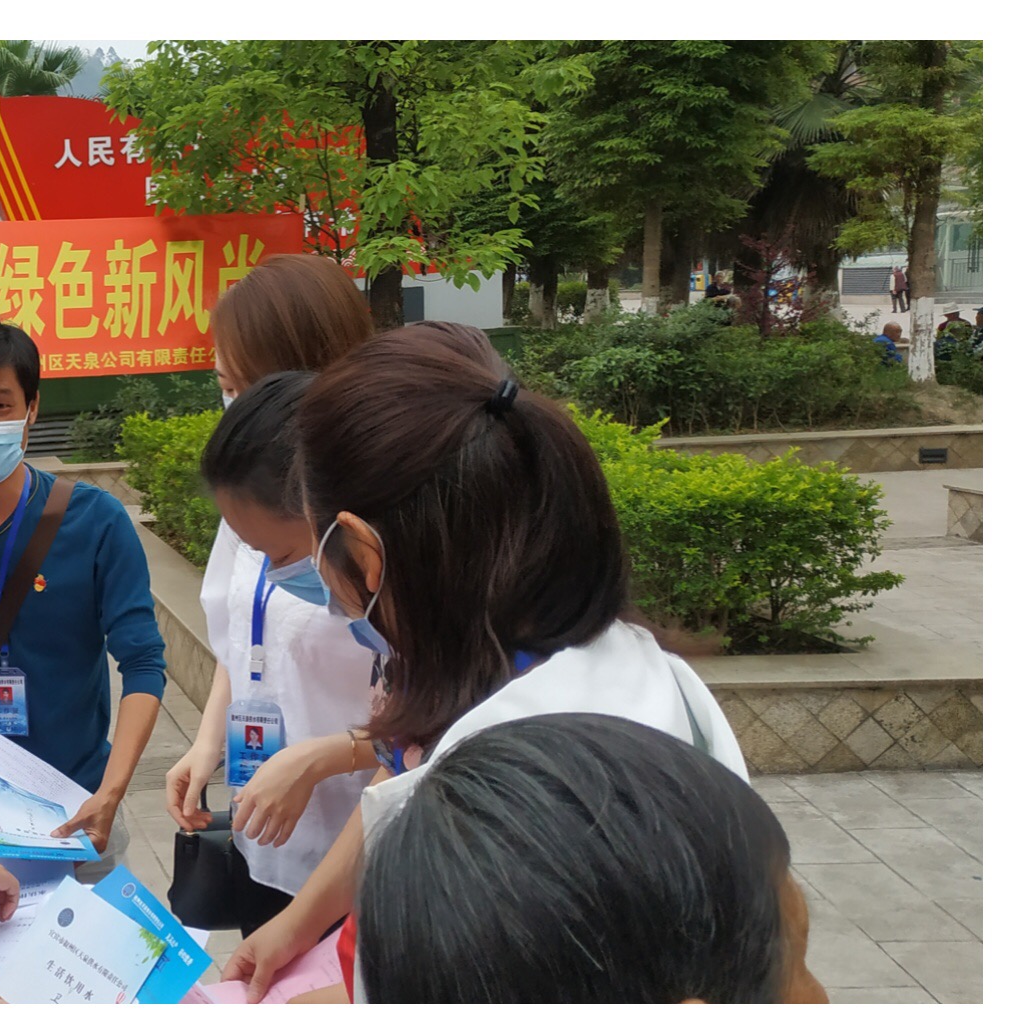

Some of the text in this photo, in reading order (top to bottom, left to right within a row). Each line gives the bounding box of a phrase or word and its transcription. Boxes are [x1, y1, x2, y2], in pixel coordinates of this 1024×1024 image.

[46, 960, 94, 1001] 生活饮用水
